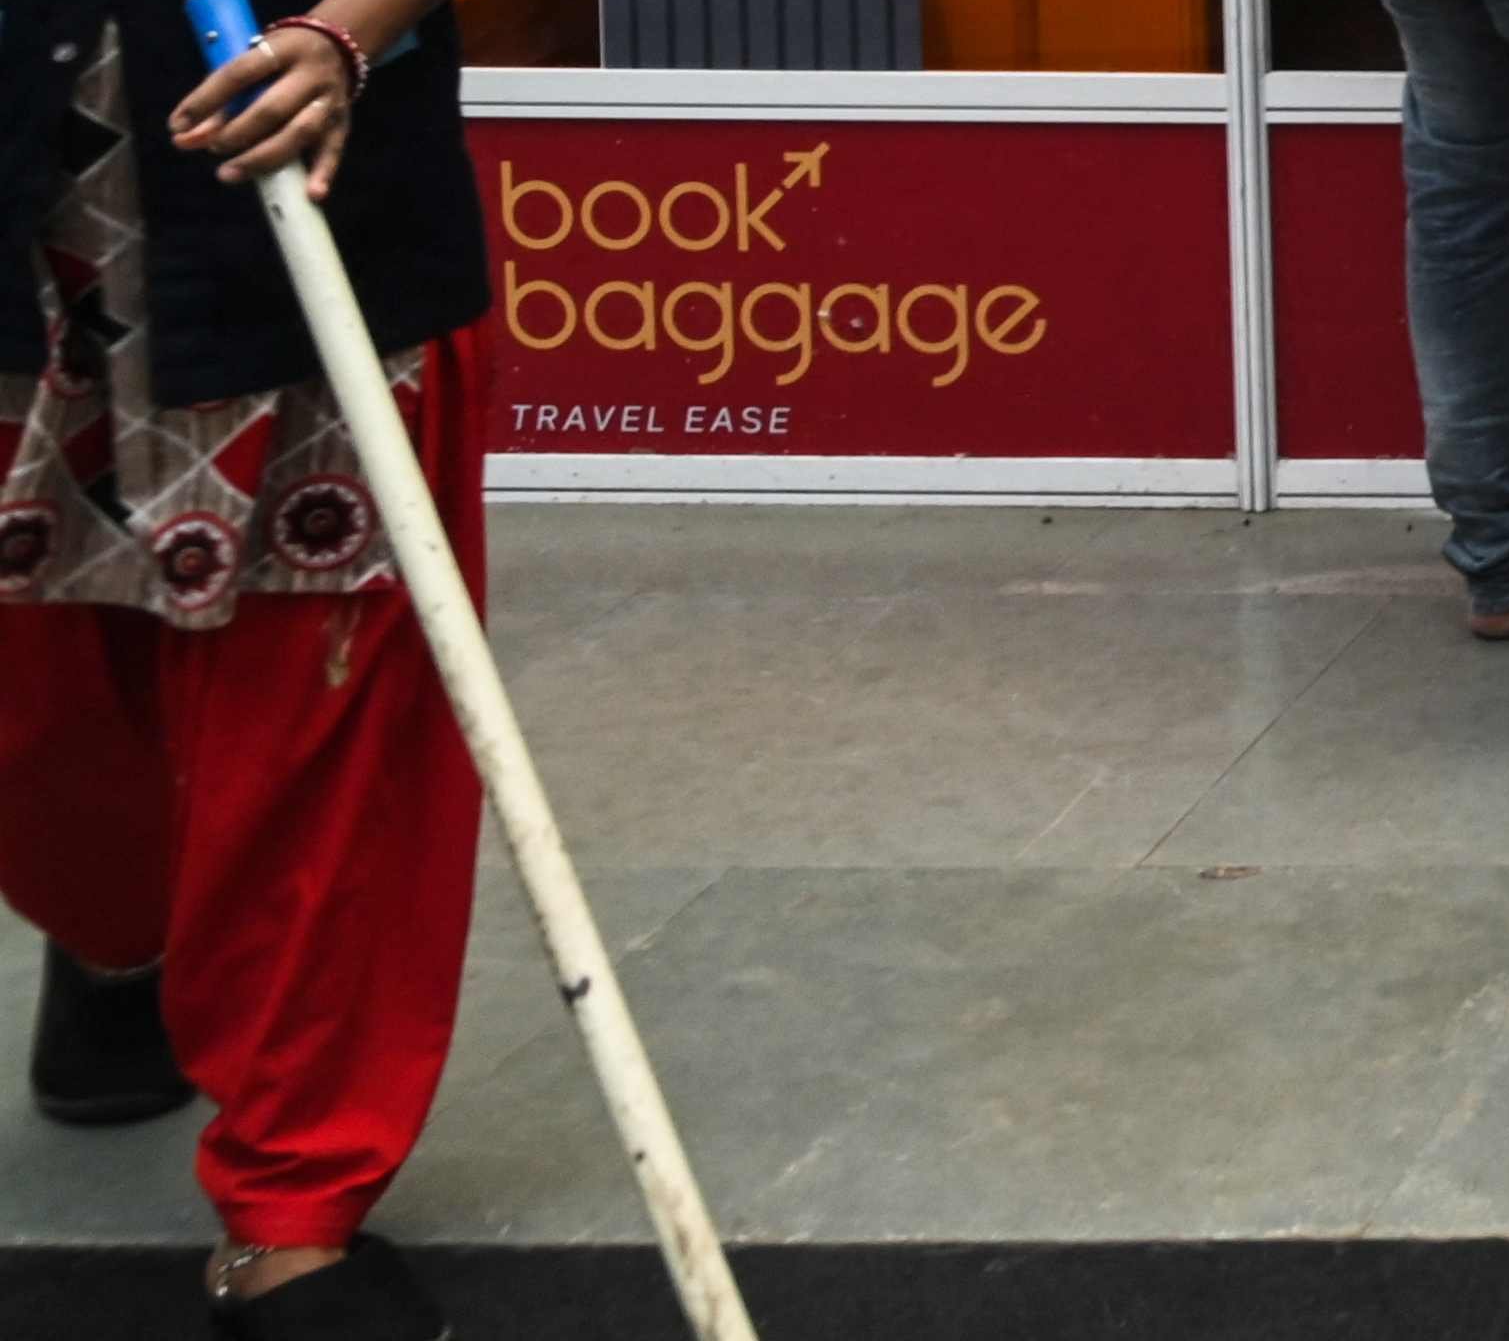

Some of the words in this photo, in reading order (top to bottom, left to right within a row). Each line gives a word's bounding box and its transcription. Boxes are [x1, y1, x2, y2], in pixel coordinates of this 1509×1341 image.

[501, 159, 786, 253] book
[503, 260, 1047, 388] baggage
[511, 403, 666, 434] TRAVEL
[684, 405, 793, 436] EASE
